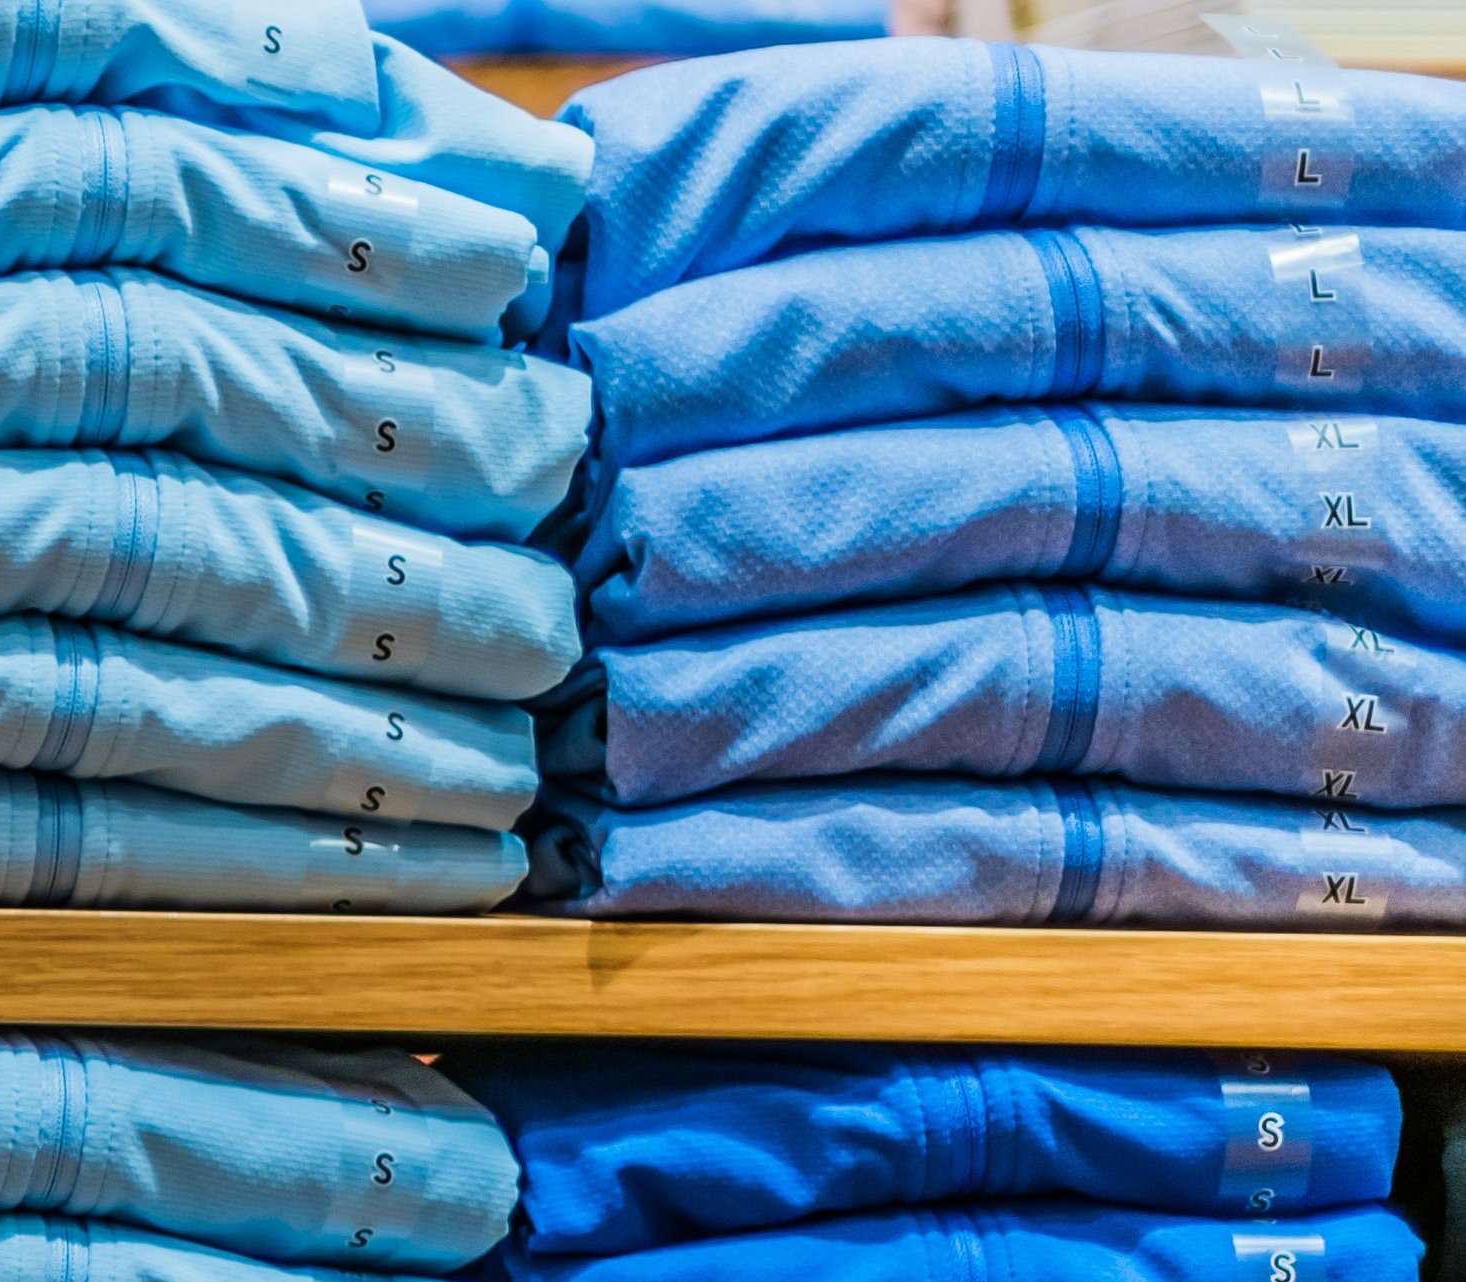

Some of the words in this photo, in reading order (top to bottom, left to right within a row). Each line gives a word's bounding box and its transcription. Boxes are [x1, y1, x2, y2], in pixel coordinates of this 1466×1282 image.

[264, 26, 282, 54] S
[1295, 82, 1320, 110] L
[1297, 149, 1322, 184] L
[366, 175, 383, 195] S
[348, 241, 371, 273] S
[1310, 270, 1334, 299] L
[375, 351, 395, 372] S
[1310, 347, 1334, 378] L
[376, 420, 397, 452] S
[1310, 424, 1360, 450] XL
[366, 492, 384, 510] S
[1323, 494, 1369, 527] XL
[387, 556, 405, 585] S
[372, 634, 395, 660] S
[1350, 624, 1396, 654] XL
[386, 713, 404, 740] S
[1340, 696, 1386, 732] XL
[1316, 770, 1358, 798] XL
[361, 787, 385, 811] S
[345, 828, 363, 854] S
[1323, 874, 1366, 904] XL
[1259, 1113, 1284, 1150] S
[374, 1154, 394, 1184] S
[1248, 1189, 1274, 1212] S
[349, 1229, 372, 1247] S
